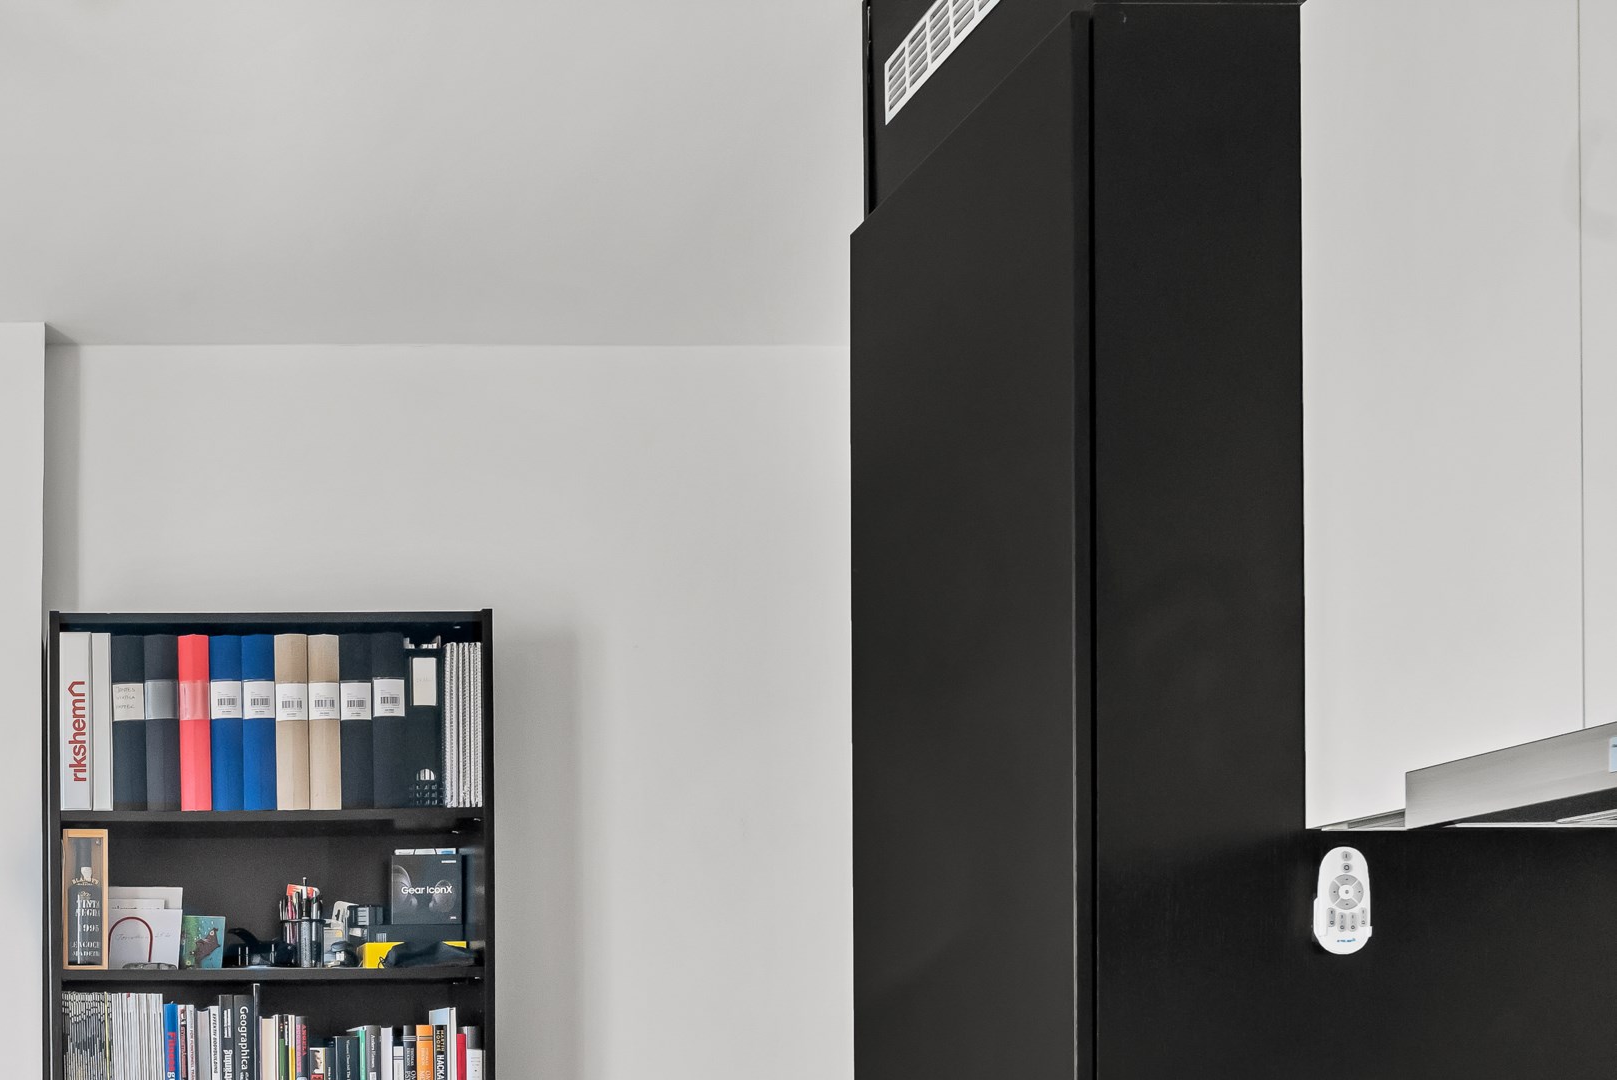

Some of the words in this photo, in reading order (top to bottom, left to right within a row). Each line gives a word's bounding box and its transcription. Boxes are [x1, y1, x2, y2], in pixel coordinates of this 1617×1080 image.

[401, 886, 425, 894] Gear
[426, 885, 453, 894] IconX
[238, 1006, 250, 1070] Geographica
